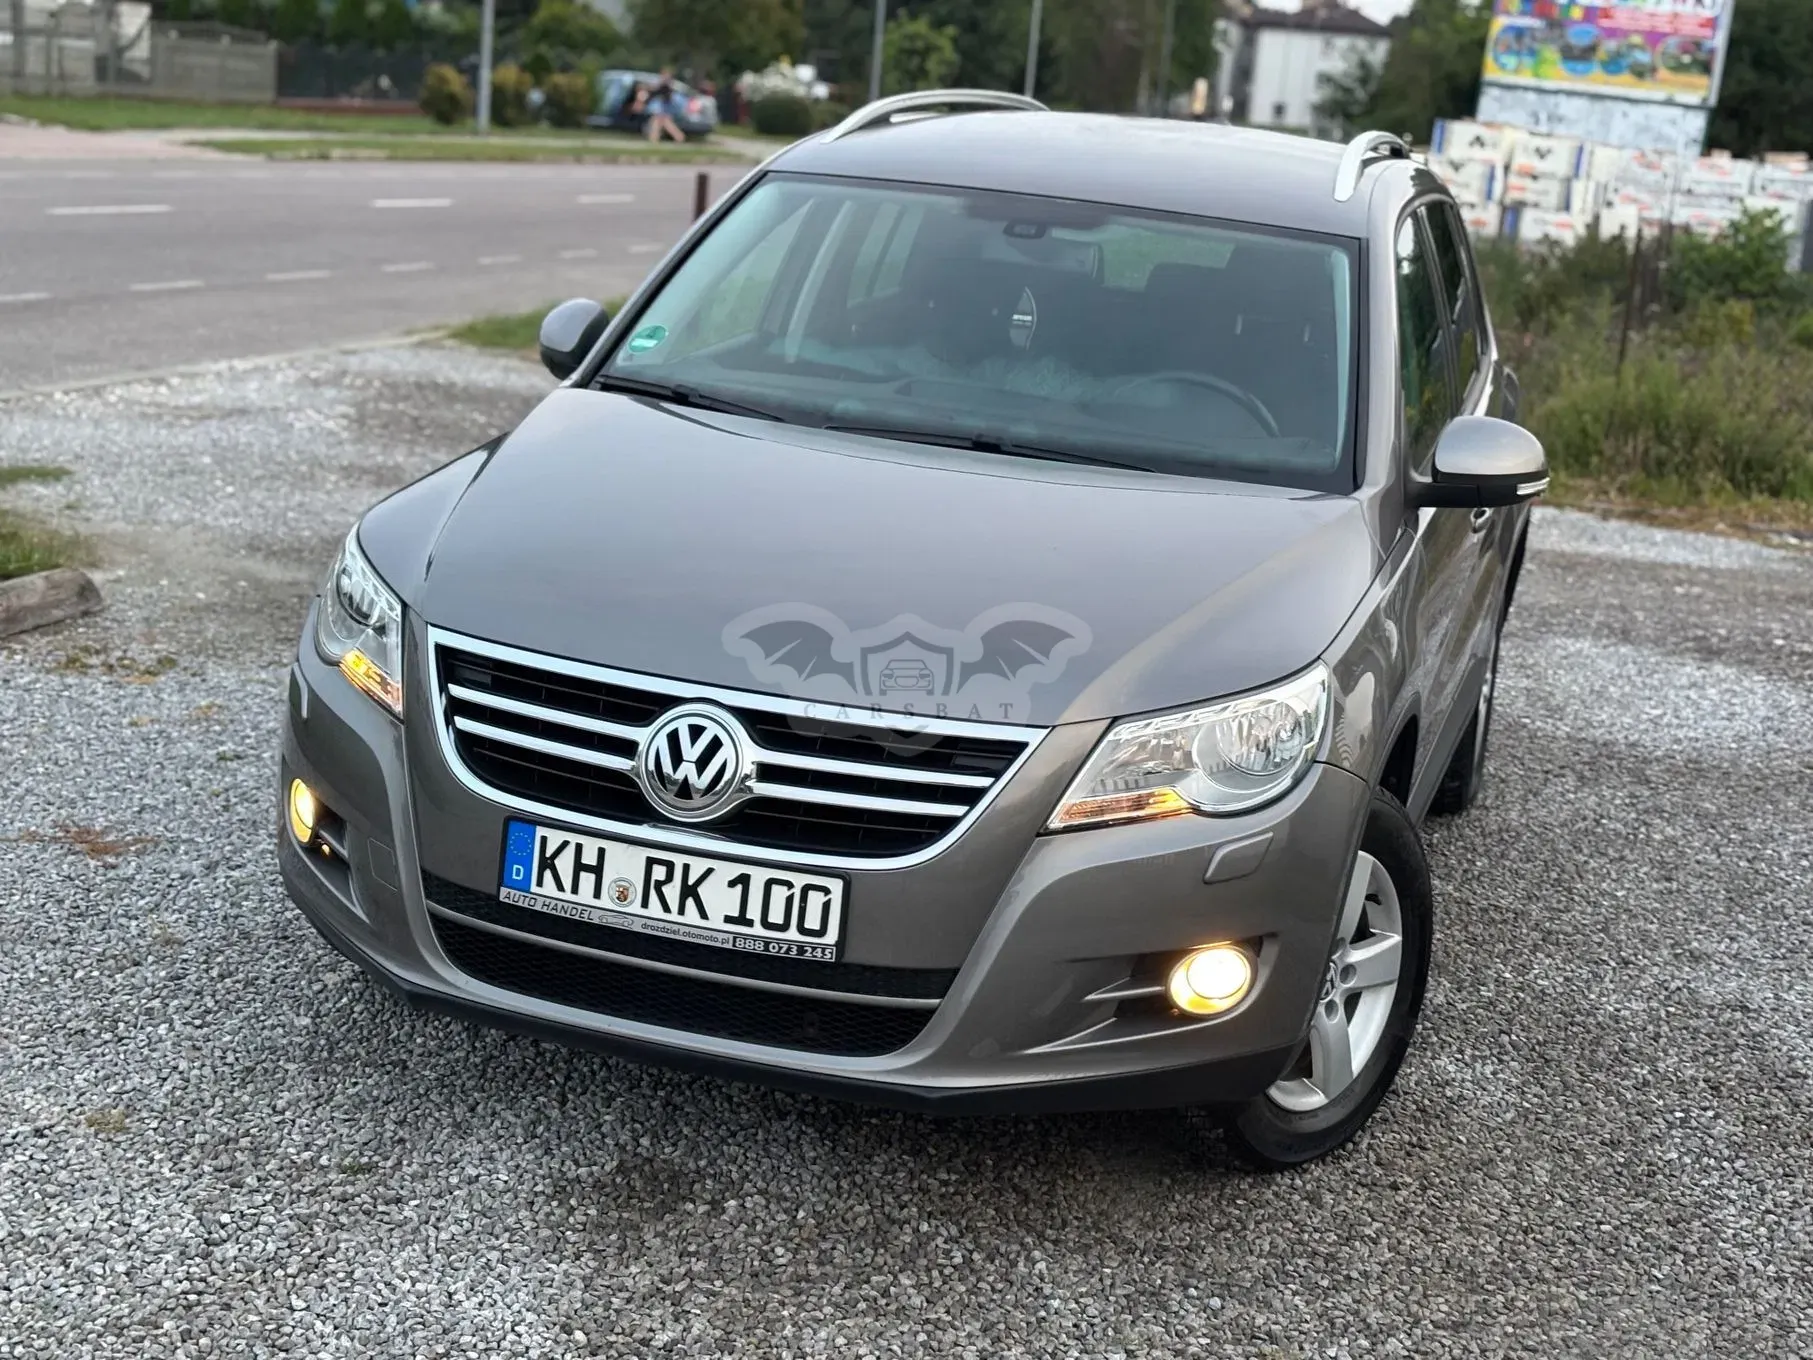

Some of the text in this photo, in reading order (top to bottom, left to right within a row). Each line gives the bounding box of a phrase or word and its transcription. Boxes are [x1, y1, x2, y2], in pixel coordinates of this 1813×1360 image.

[511, 864, 524, 881] D
[535, 834, 606, 900] KH
[503, 890, 594, 921] AUTO HANDEL
[640, 922, 730, 946] drozdziel.otomoto.pl
[735, 937, 833, 959] 888 073 245
